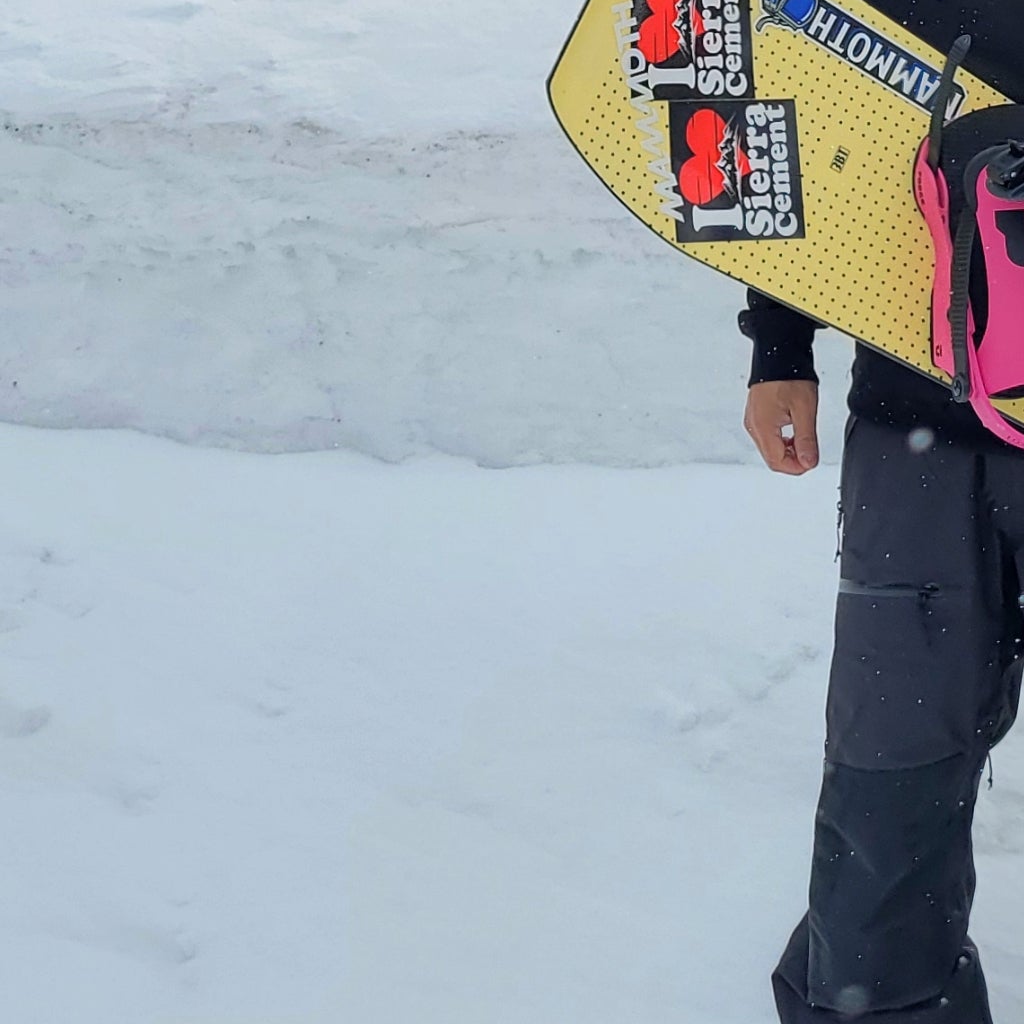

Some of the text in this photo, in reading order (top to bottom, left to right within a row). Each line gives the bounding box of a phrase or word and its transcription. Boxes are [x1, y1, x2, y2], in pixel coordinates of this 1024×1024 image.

[611, 0, 685, 223] MAMMOTH
[648, 63, 695, 89] I
[744, 102, 774, 236] Sierra
[692, 203, 743, 232] I
